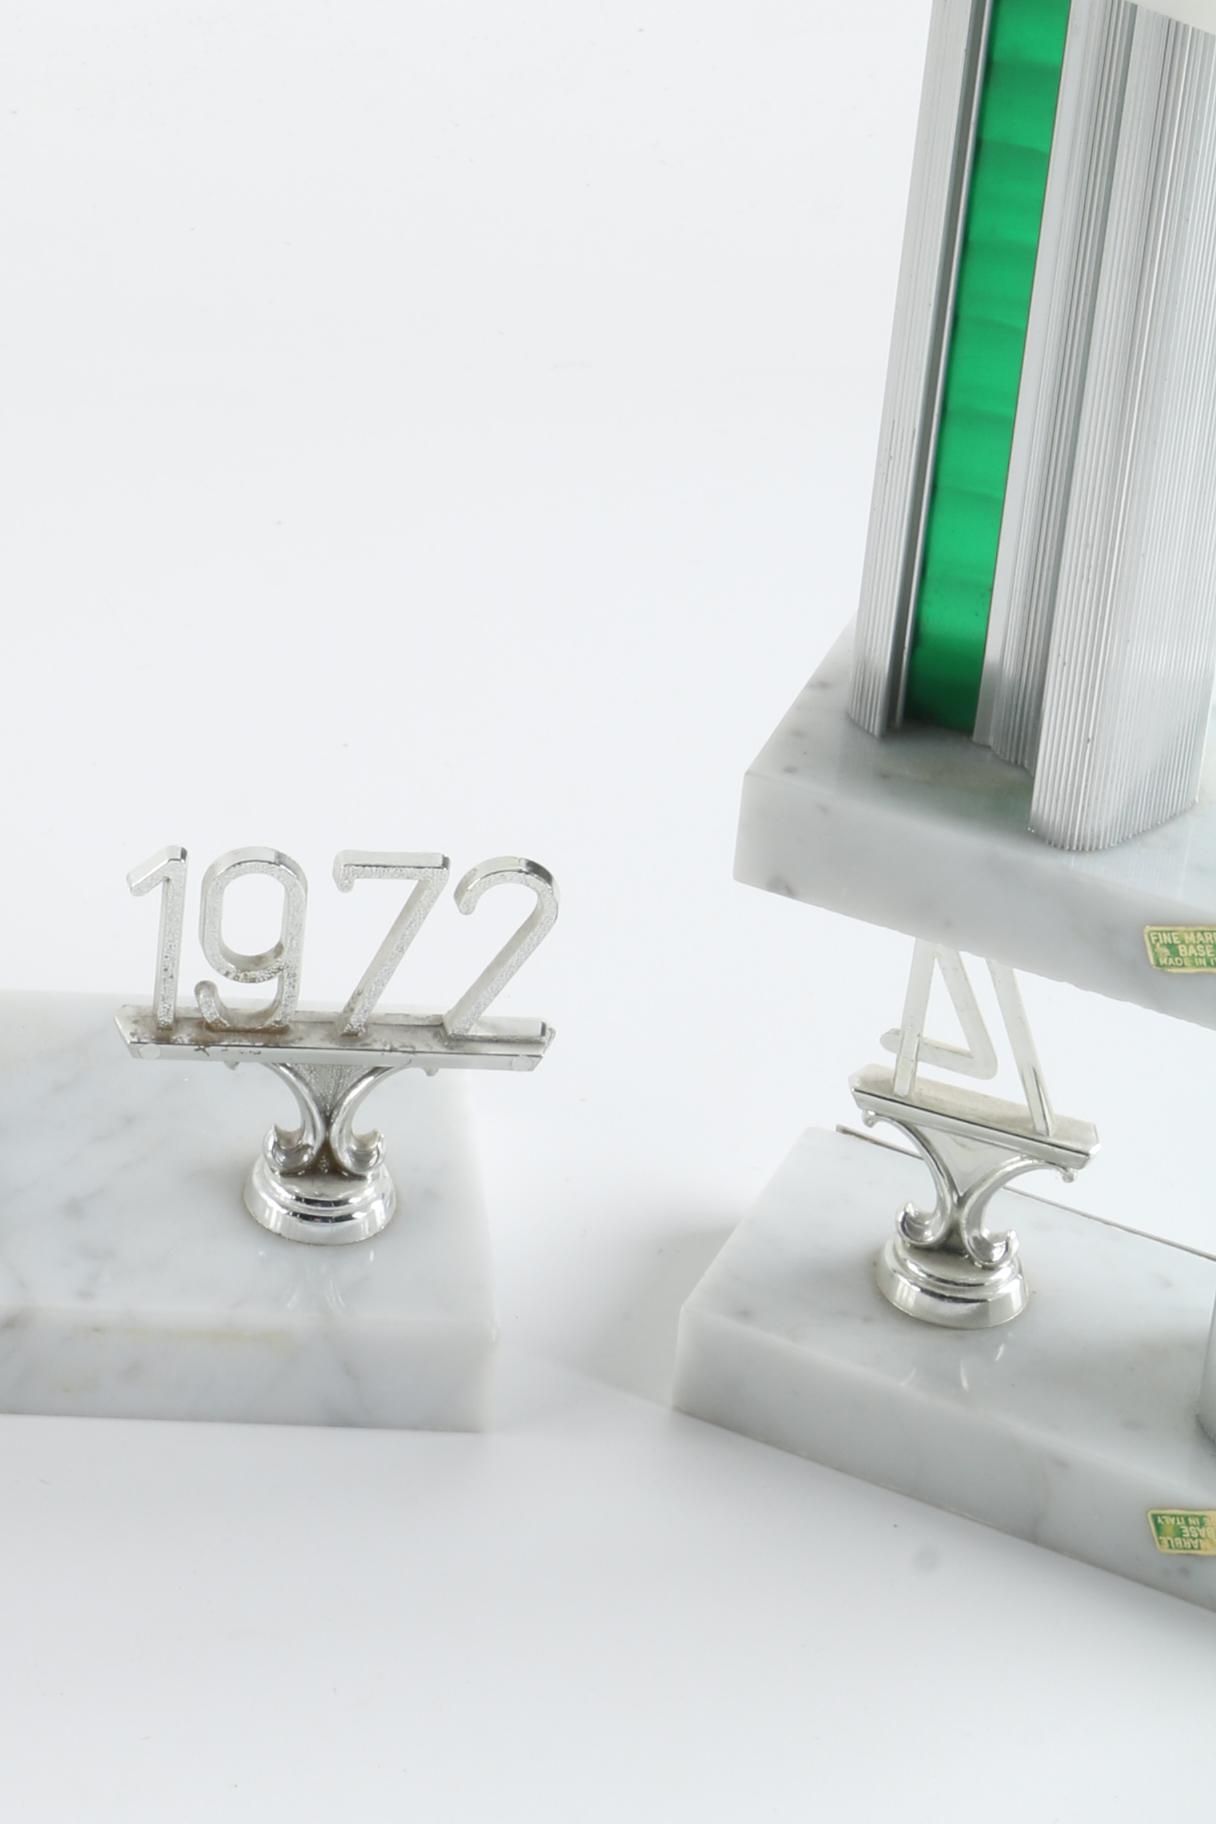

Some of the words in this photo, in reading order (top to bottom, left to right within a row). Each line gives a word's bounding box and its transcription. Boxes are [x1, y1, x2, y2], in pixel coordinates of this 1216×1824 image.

[126, 844, 559, 1042] 1972
[1150, 932, 1181, 944] FINE
[1184, 932, 1216, 945] MAR
[1178, 944, 1215, 957] BASE
[1159, 957, 1192, 967] MADE
